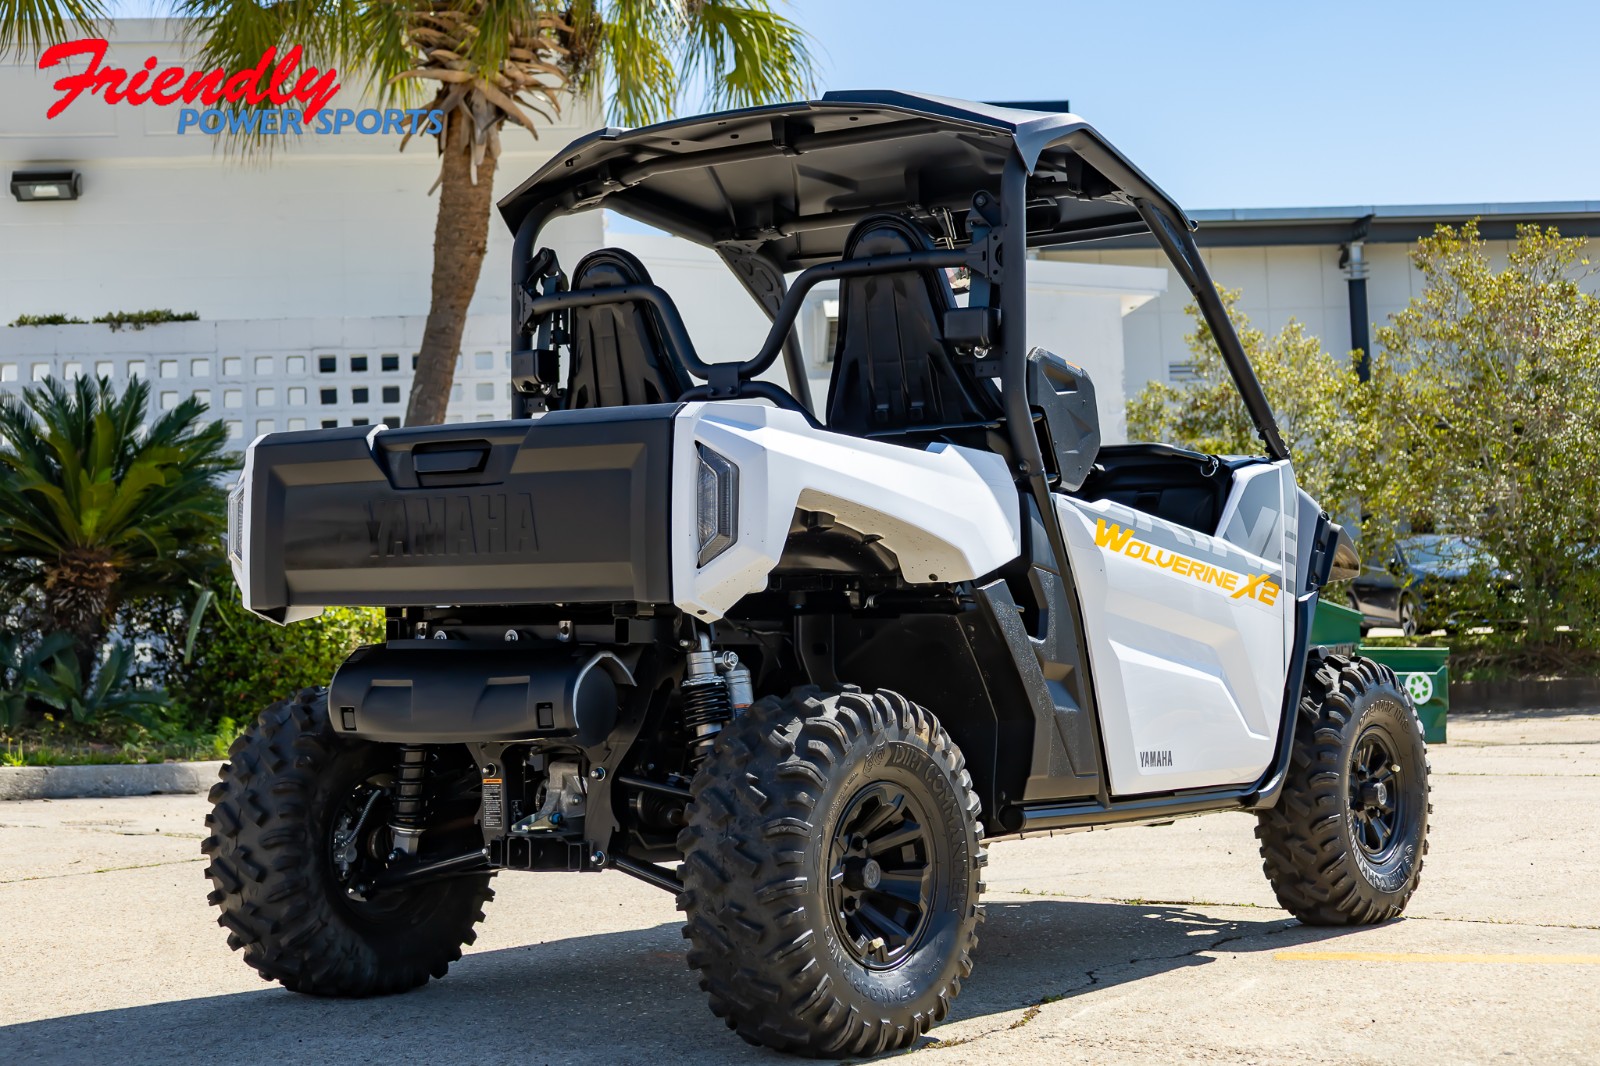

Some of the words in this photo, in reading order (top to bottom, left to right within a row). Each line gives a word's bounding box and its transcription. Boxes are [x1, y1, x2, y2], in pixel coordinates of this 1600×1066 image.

[365, 492, 540, 558] YAMAHA
[1229, 573, 1280, 607] X2
[892, 744, 927, 772] DIRT
[1139, 750, 1173, 768] YAMAHA
